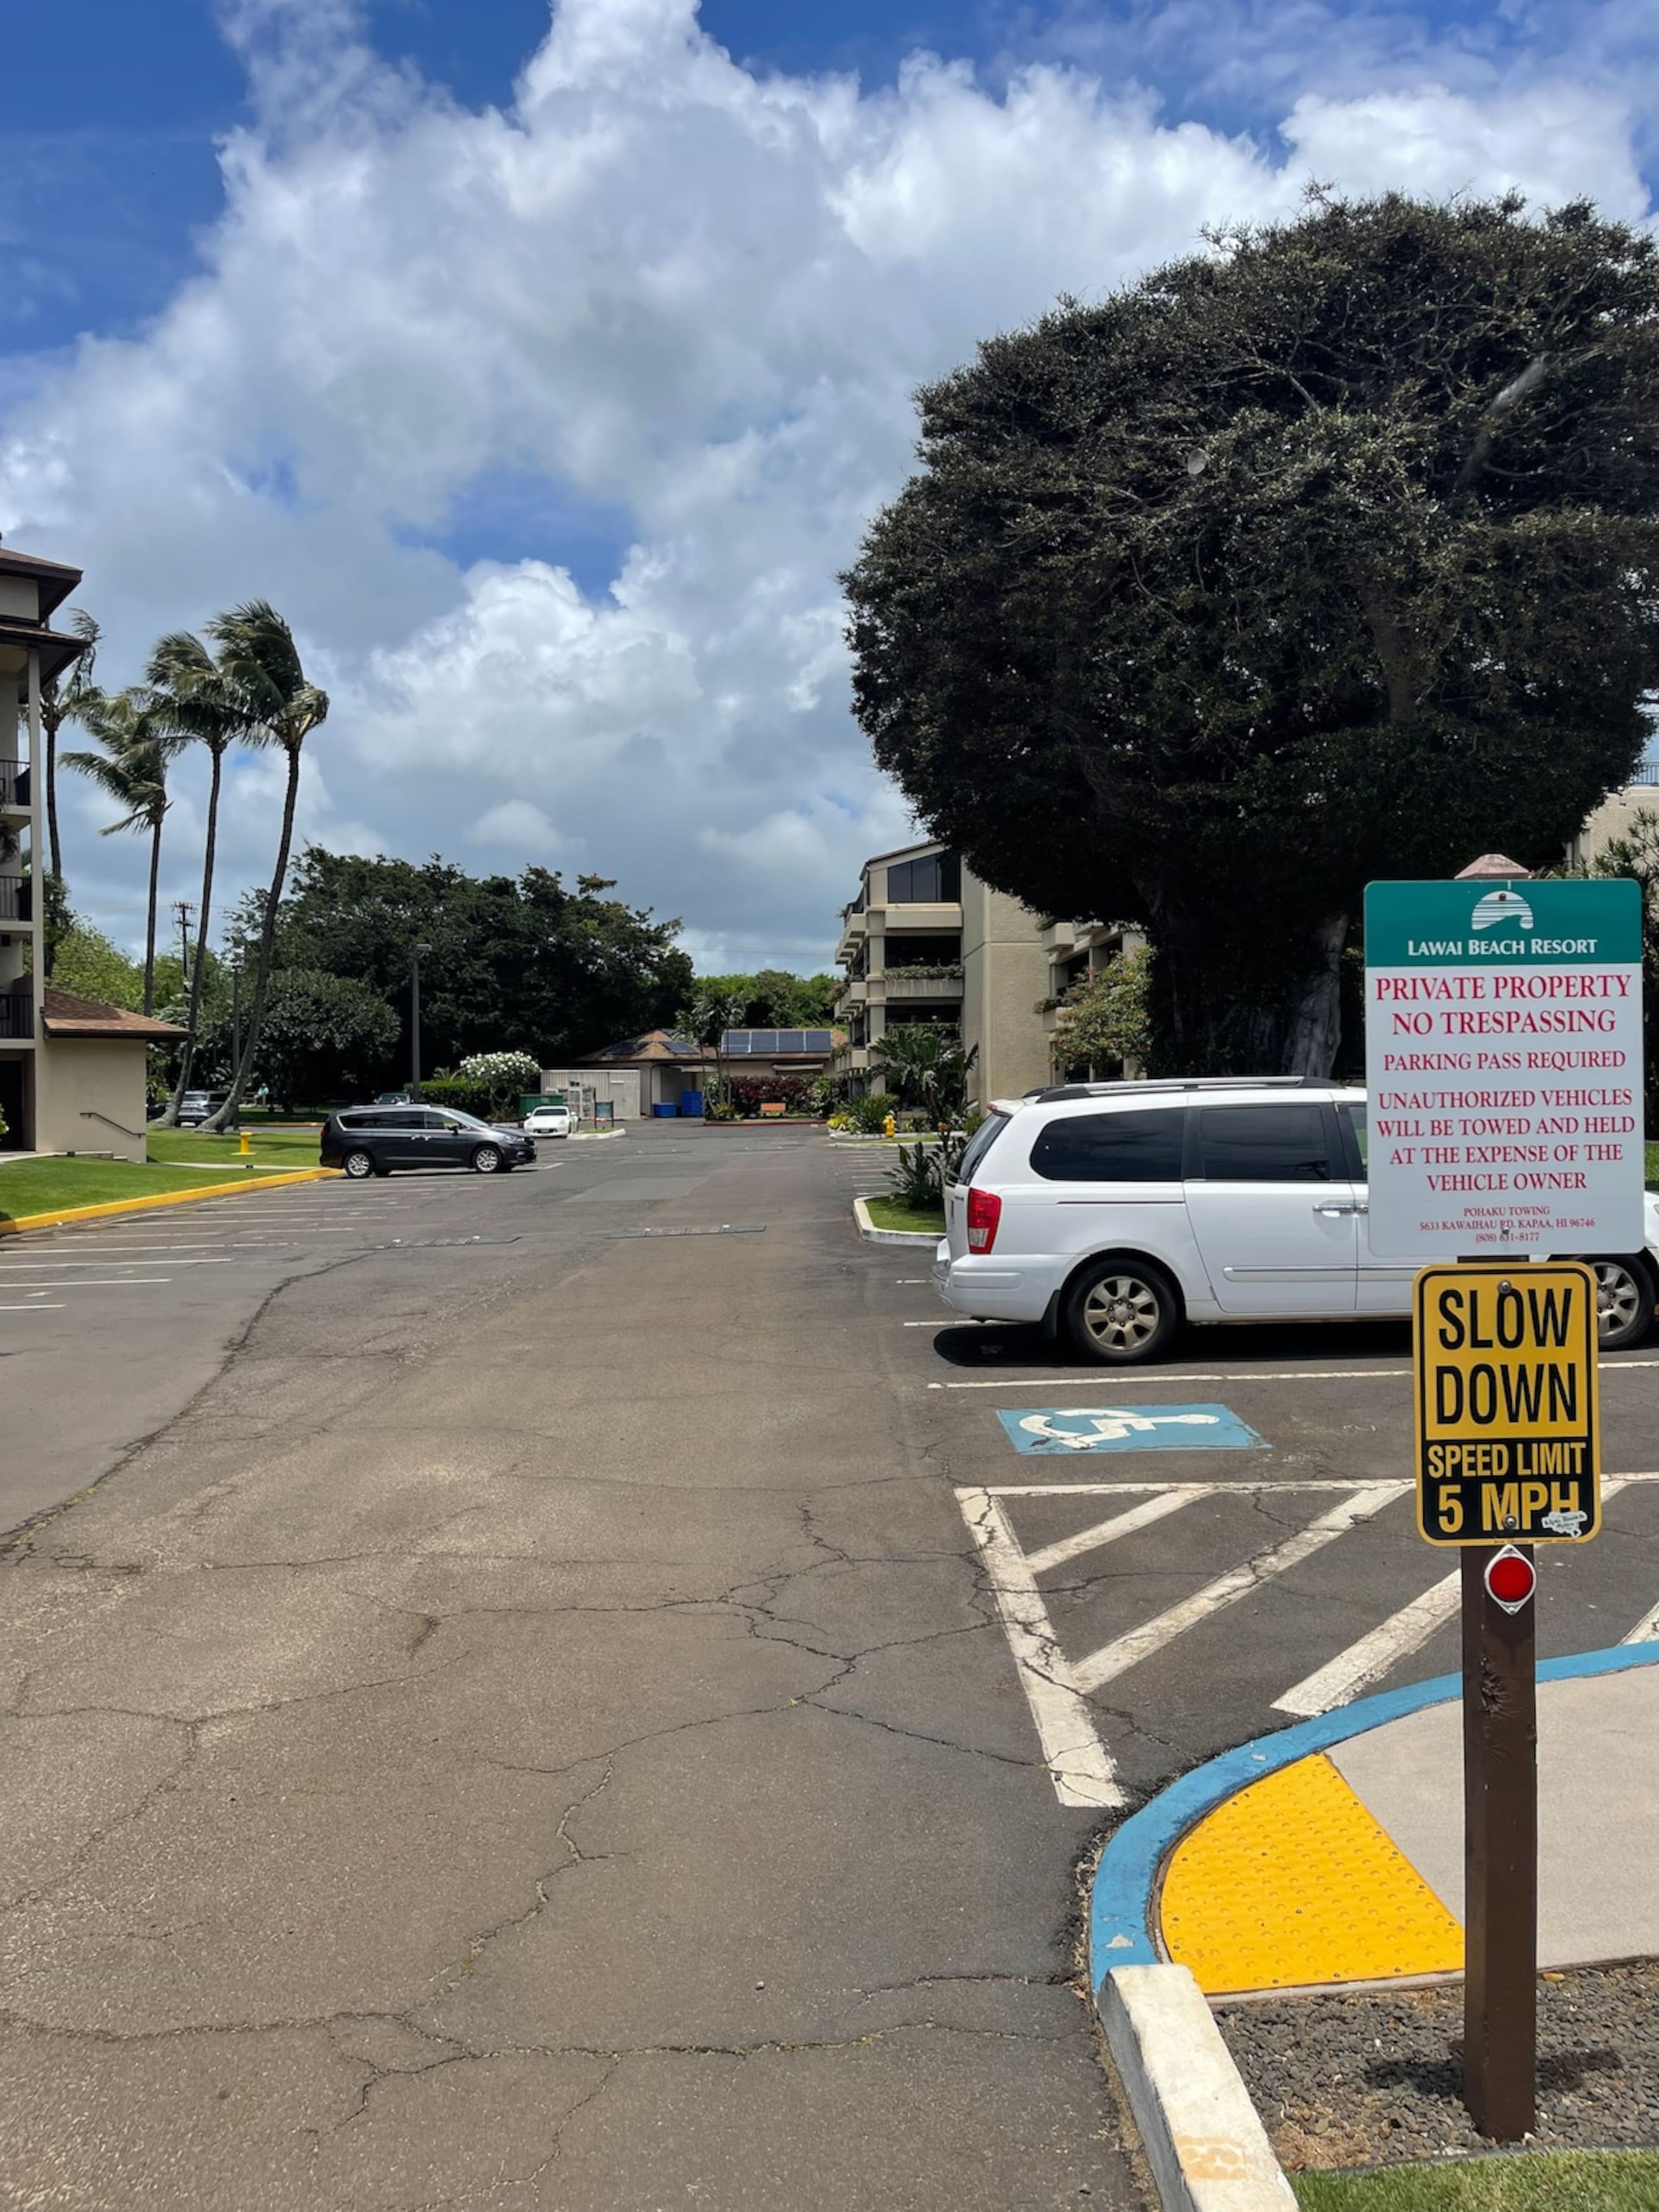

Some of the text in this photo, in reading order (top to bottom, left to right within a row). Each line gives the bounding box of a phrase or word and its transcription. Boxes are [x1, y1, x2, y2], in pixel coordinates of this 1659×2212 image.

[1409, 938, 1597, 955] LAWAI BEACH RESORT
[1375, 975, 1632, 1001] PRIVATE PROPERTY
[1393, 1009, 1616, 1034] NO TRESPASSING
[1384, 1051, 1626, 1071] PARKING PASS REQUIRED
[1379, 1089, 1632, 1110] UNAUTHORIZED VEHICLES
[1376, 1117, 1634, 1137] WILL BE TOWED AND HELD
[1390, 1145, 1623, 1164] AT THE EXPENSE OF THE
[1427, 1173, 1586, 1191] VEHICLE OWNER
[1464, 1206, 1550, 1217] POHAKU TOWING
[1420, 1222, 1439, 1230] 5633
[1442, 1220, 1496, 1229] KAWAIHAU
[1518, 1219, 1553, 1229] KAPAA,
[1556, 1219, 1567, 1228] HI
[1570, 1218, 1595, 1228] 96746
[1476, 1233, 1496, 1244] (808)
[1439, 1288, 1572, 1349] SLOW
[1437, 1364, 1577, 1425] DOWN
[1428, 1443, 1586, 1478] SPEED LIMIT
[1438, 1485, 1463, 1533] 5
[1482, 1481, 1580, 1531] MPH
